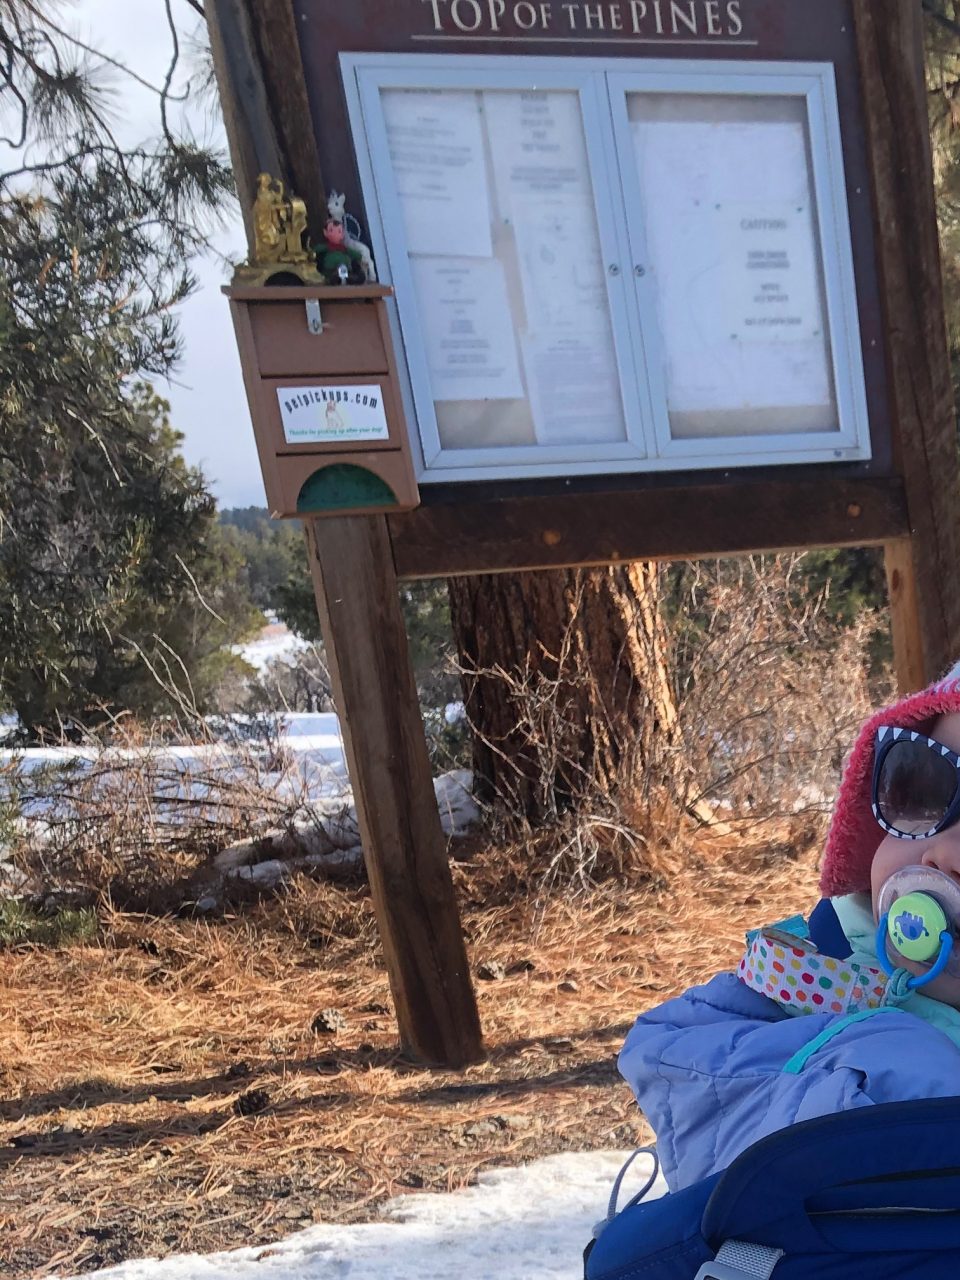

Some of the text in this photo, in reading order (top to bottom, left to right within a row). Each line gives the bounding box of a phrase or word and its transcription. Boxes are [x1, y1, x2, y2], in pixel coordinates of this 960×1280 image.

[421, 0, 743, 35] TOP OF THE PINES
[284, 388, 378, 414] petpickups.com
